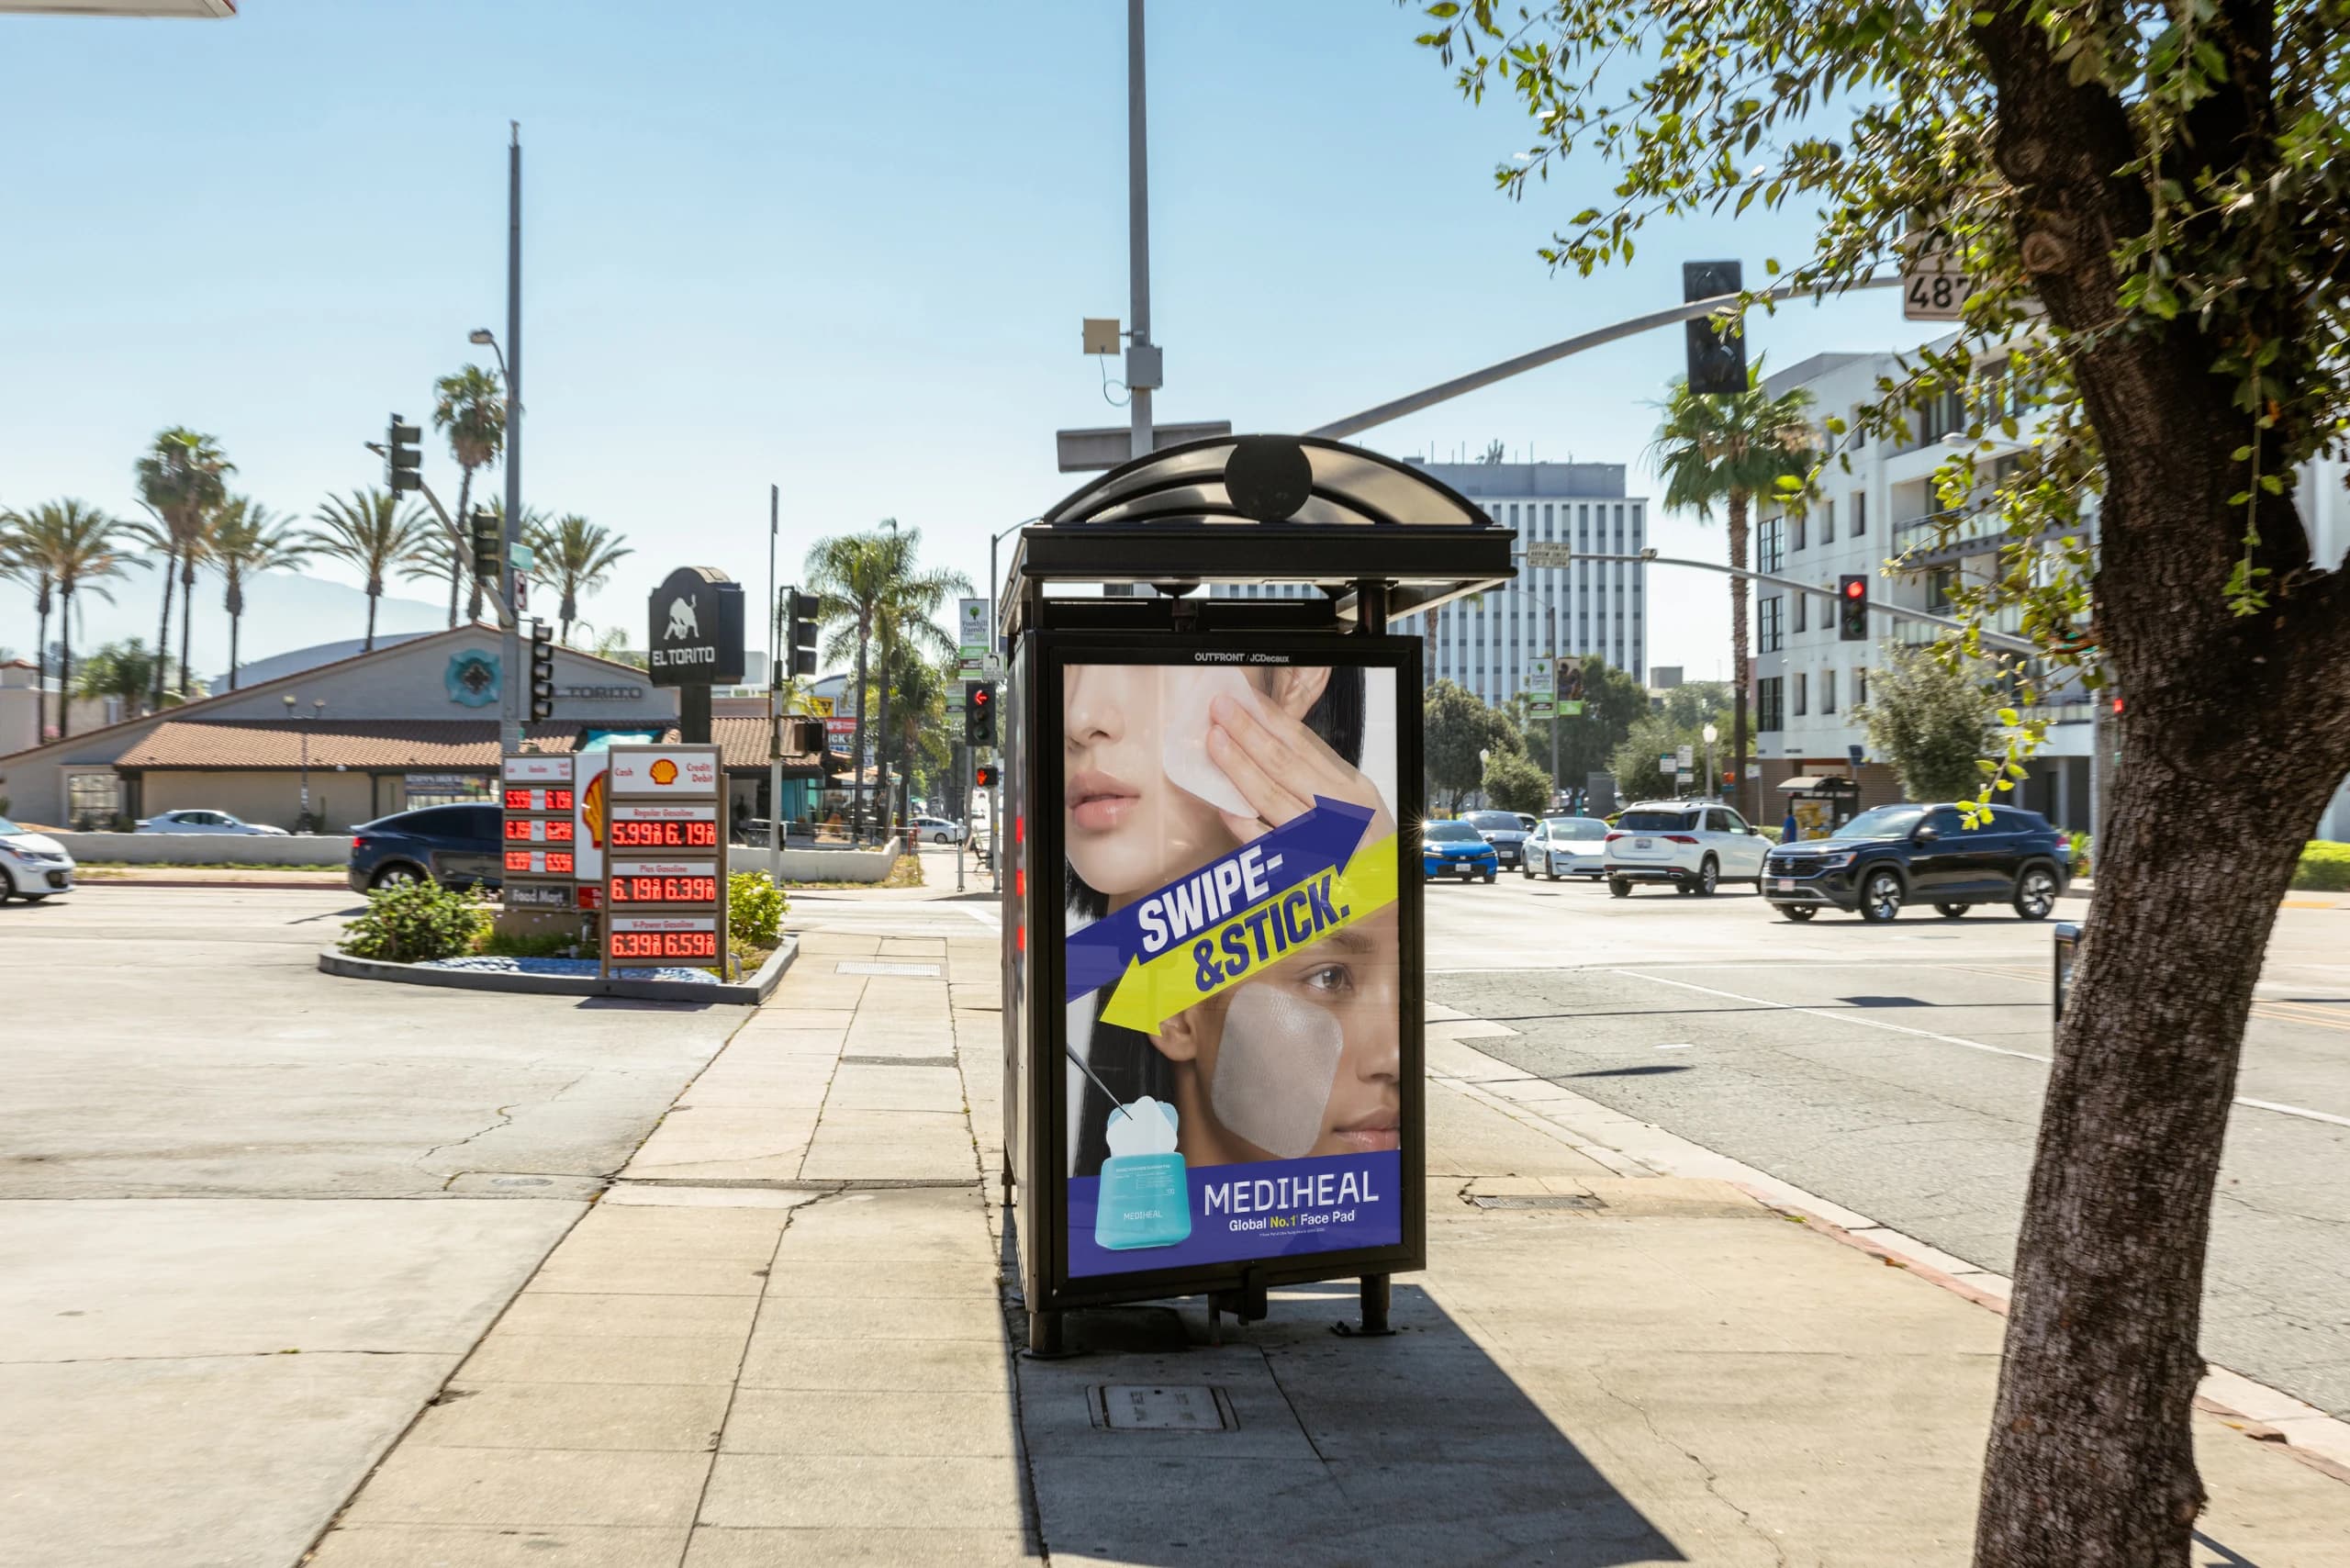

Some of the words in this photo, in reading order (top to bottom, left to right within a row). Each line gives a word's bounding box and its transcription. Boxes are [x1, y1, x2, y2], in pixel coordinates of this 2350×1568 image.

[652, 650, 667, 666] EL
[667, 646, 715, 665] TORITO
[1194, 653, 1245, 662] OUTFRONT
[1249, 653, 1290, 663] JCDecaux
[566, 687, 642, 699] TORITO
[615, 767, 633, 777] Cash
[692, 774, 713, 782] Debit
[633, 809, 661, 818] Regular
[663, 809, 694, 817] Gasoline
[640, 865, 655, 873] Plus
[656, 865, 688, 873] Gasoline
[513, 889, 537, 902] Food
[538, 889, 563, 902] Mart
[1138, 844, 1283, 953] SWIPE-
[663, 920, 695, 928] Gasoline
[1193, 875, 1350, 992] &STICK.
[1204, 1170, 1379, 1216] MEDIHEAL
[1124, 1210, 1163, 1220] MEDIHEAL
[1229, 1217, 1266, 1231] Global
[1301, 1214, 1329, 1226] Face
[1333, 1210, 1355, 1223] Pad
